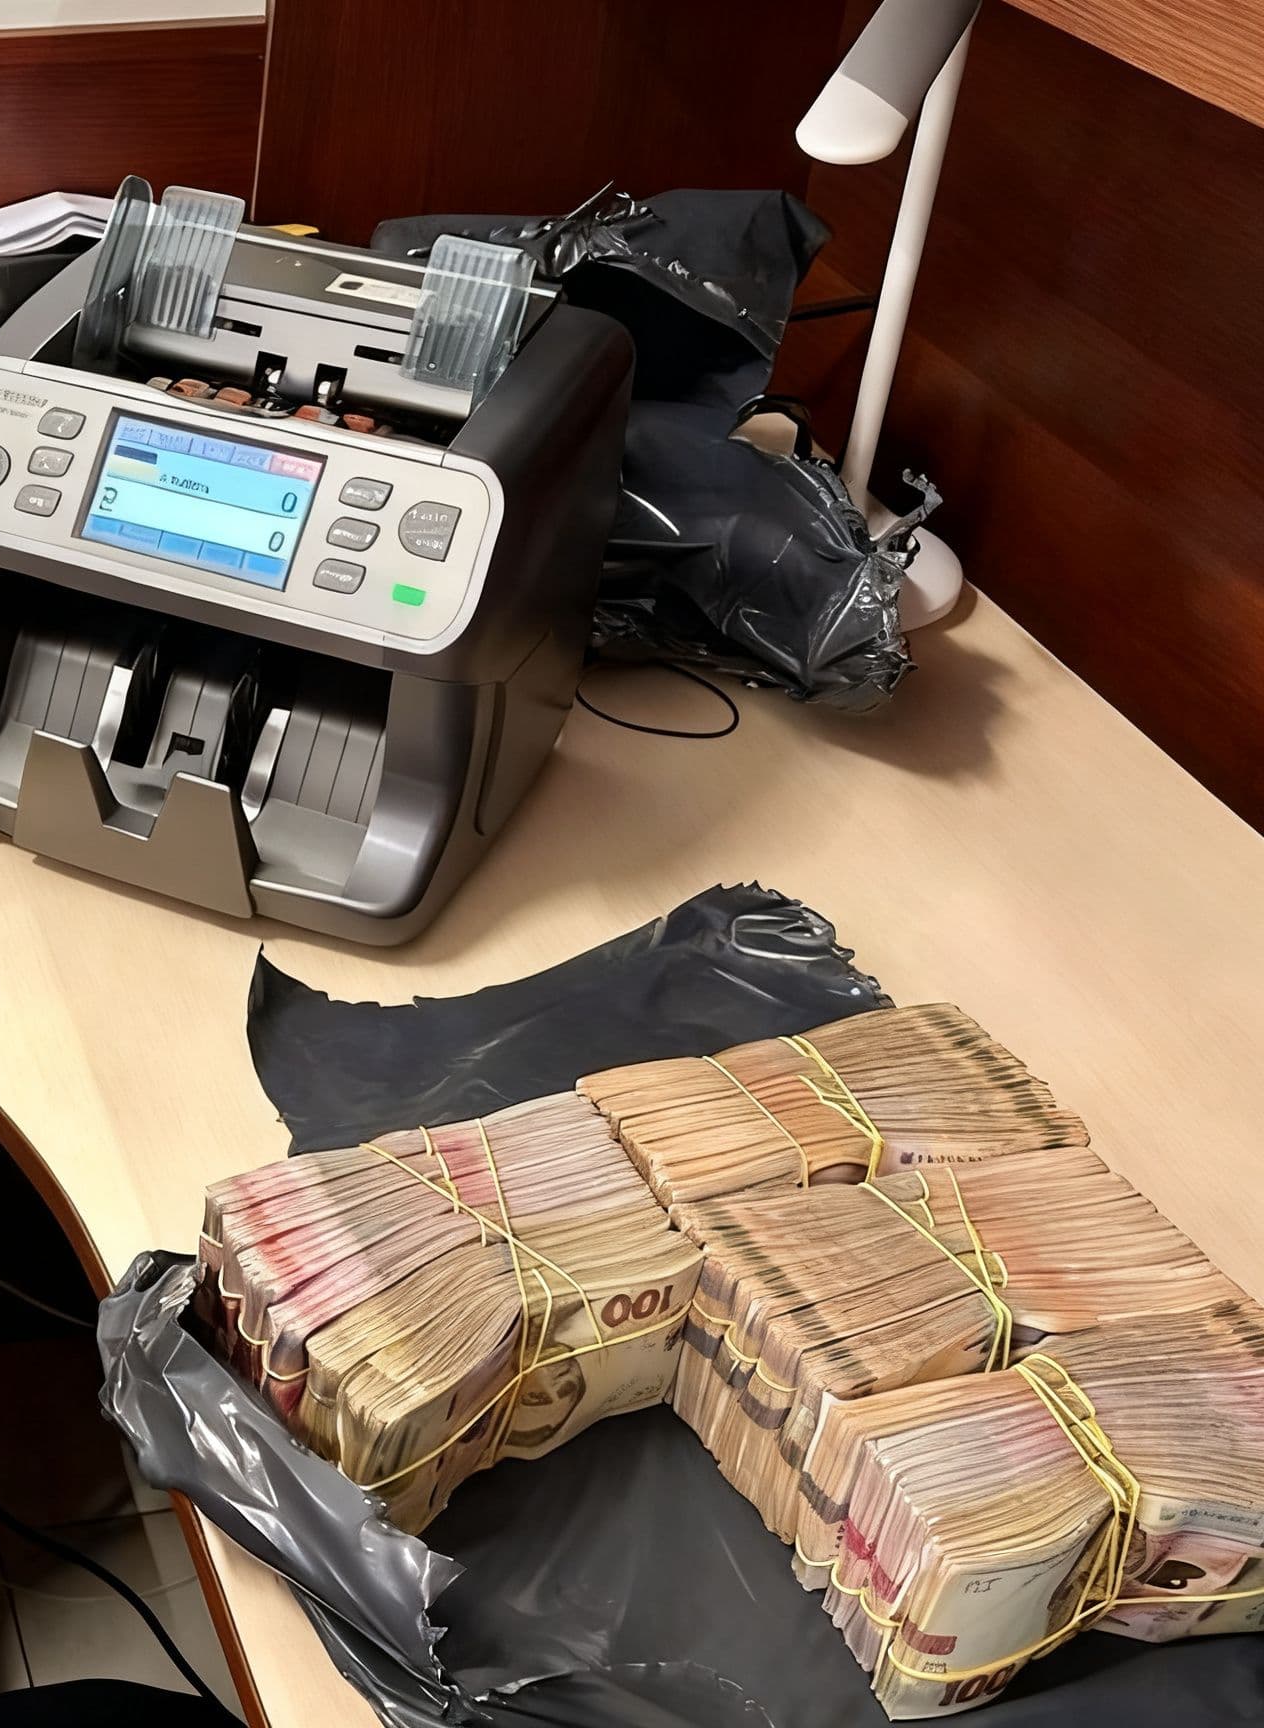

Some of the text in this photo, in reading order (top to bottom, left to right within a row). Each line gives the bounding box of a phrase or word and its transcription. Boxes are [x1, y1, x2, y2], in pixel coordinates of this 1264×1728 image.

[282, 492, 297, 513] 0
[268, 531, 285, 552] 0
[938, 1663, 1016, 1706] 100
